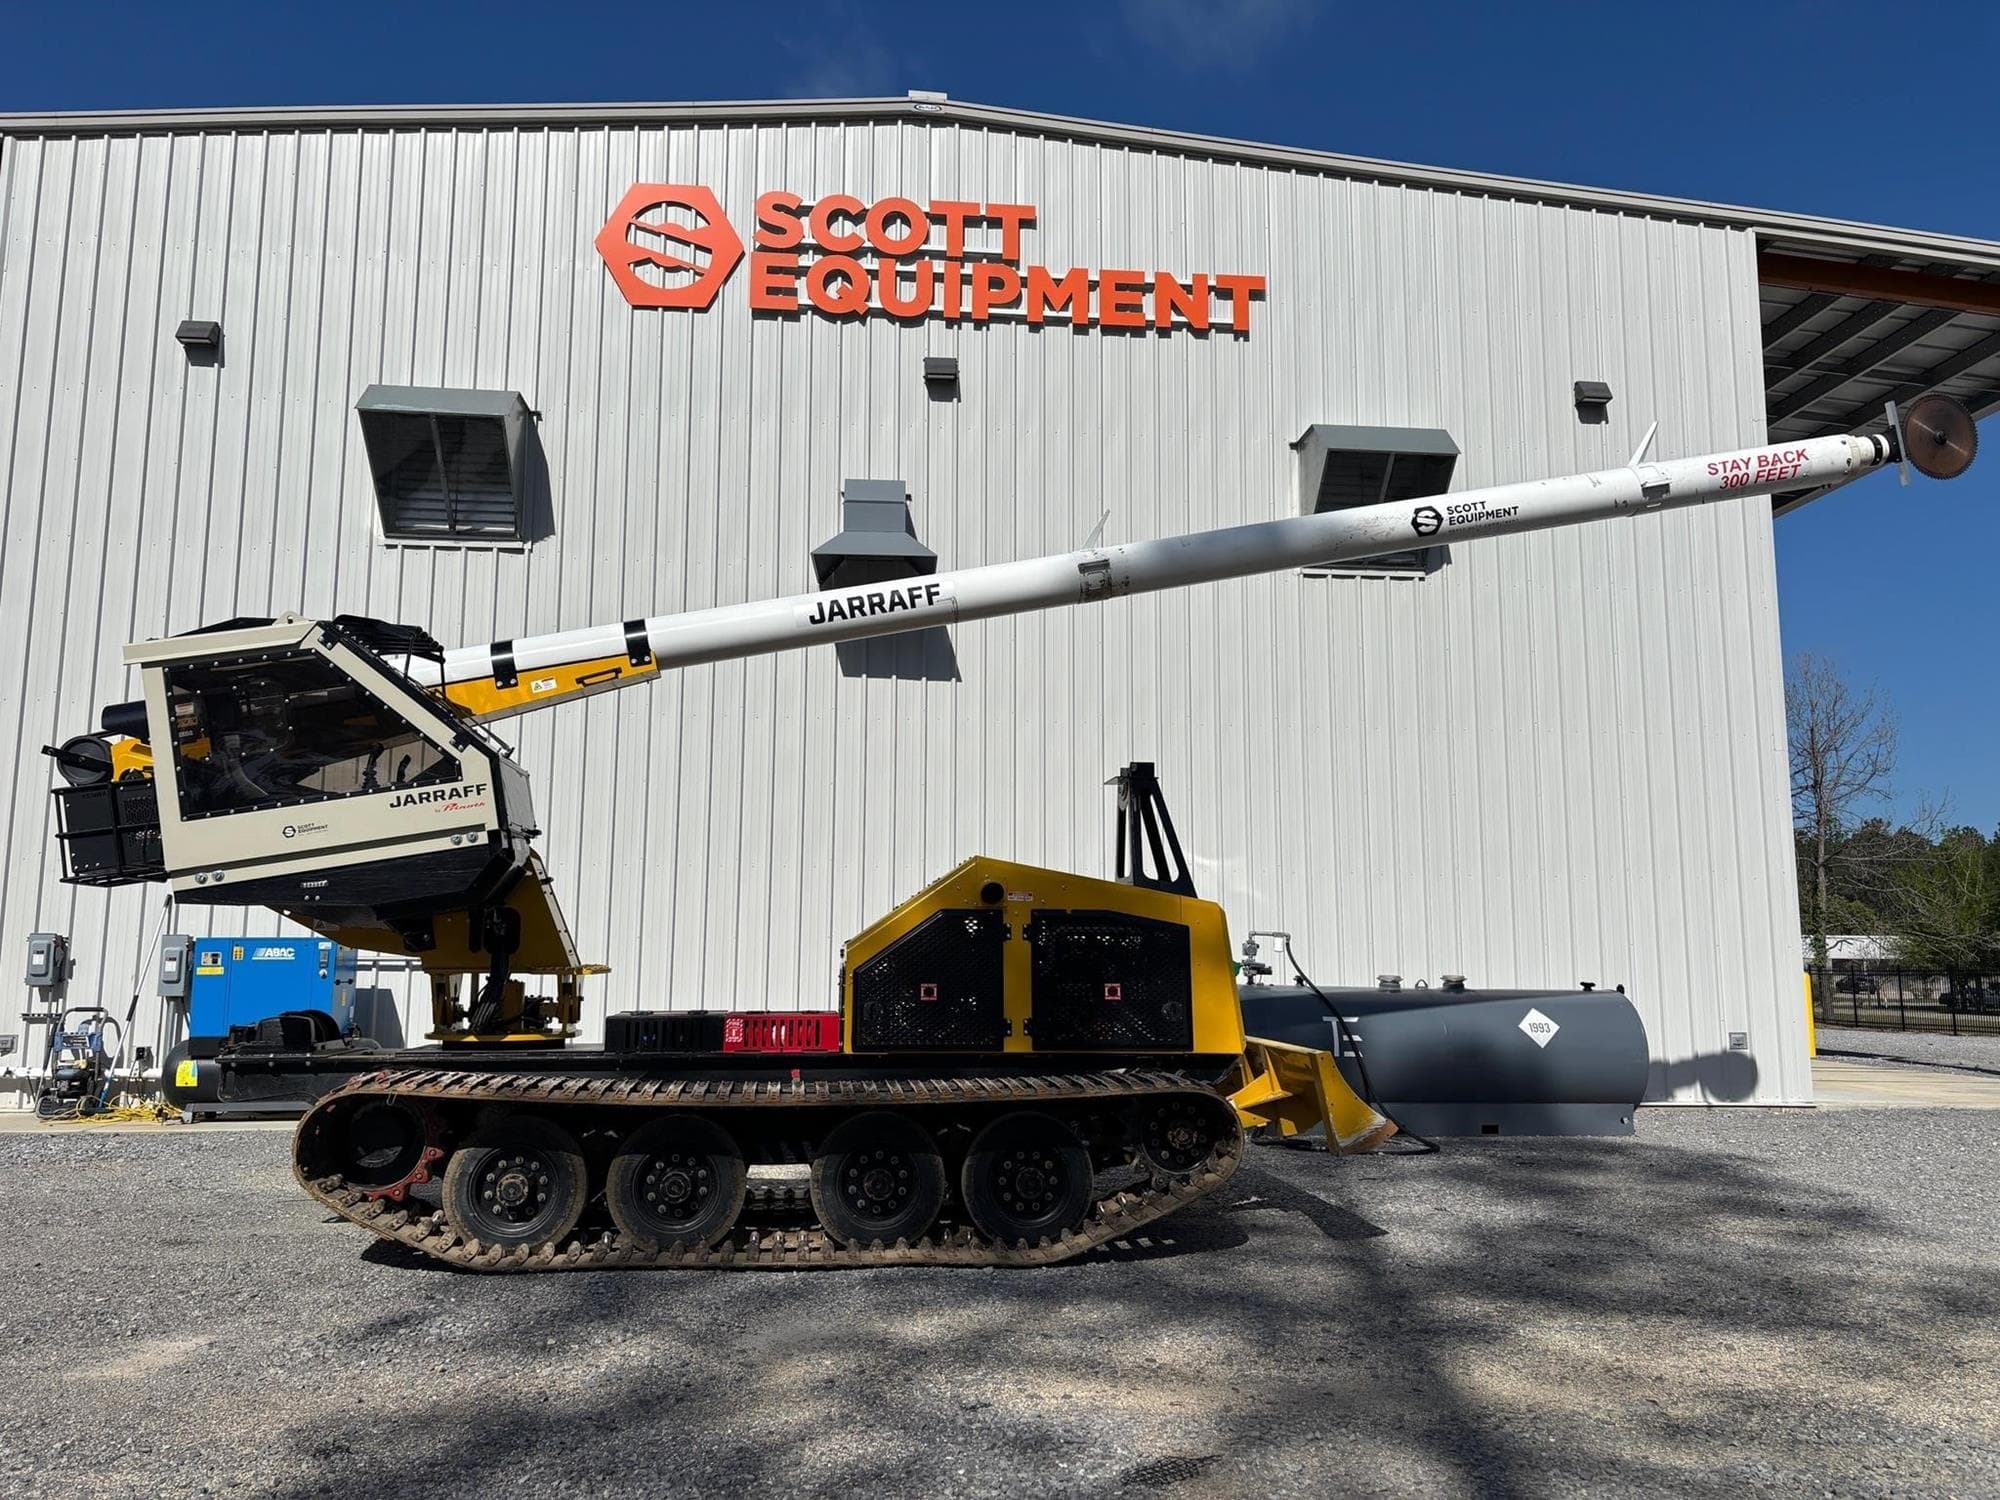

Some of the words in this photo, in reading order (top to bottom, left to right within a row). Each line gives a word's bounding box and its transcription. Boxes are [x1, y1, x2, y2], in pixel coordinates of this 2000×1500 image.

[753, 190, 1037, 260] SCOTT
[749, 252, 1266, 332] EQUIPMENT
[1707, 457, 1752, 476] STAY
[1757, 449, 1810, 469] BACK
[1719, 472, 1750, 490] 300
[1754, 464, 1802, 484] FEET
[1446, 501, 1487, 515] SCOTT
[1448, 506, 1519, 526] EQUIPMENT
[809, 583, 940, 625] JARRAFF
[389, 783, 488, 808] JARRAFF
[264, 947, 295, 957] ABAC
[1528, 1022, 1551, 1033] 1993
